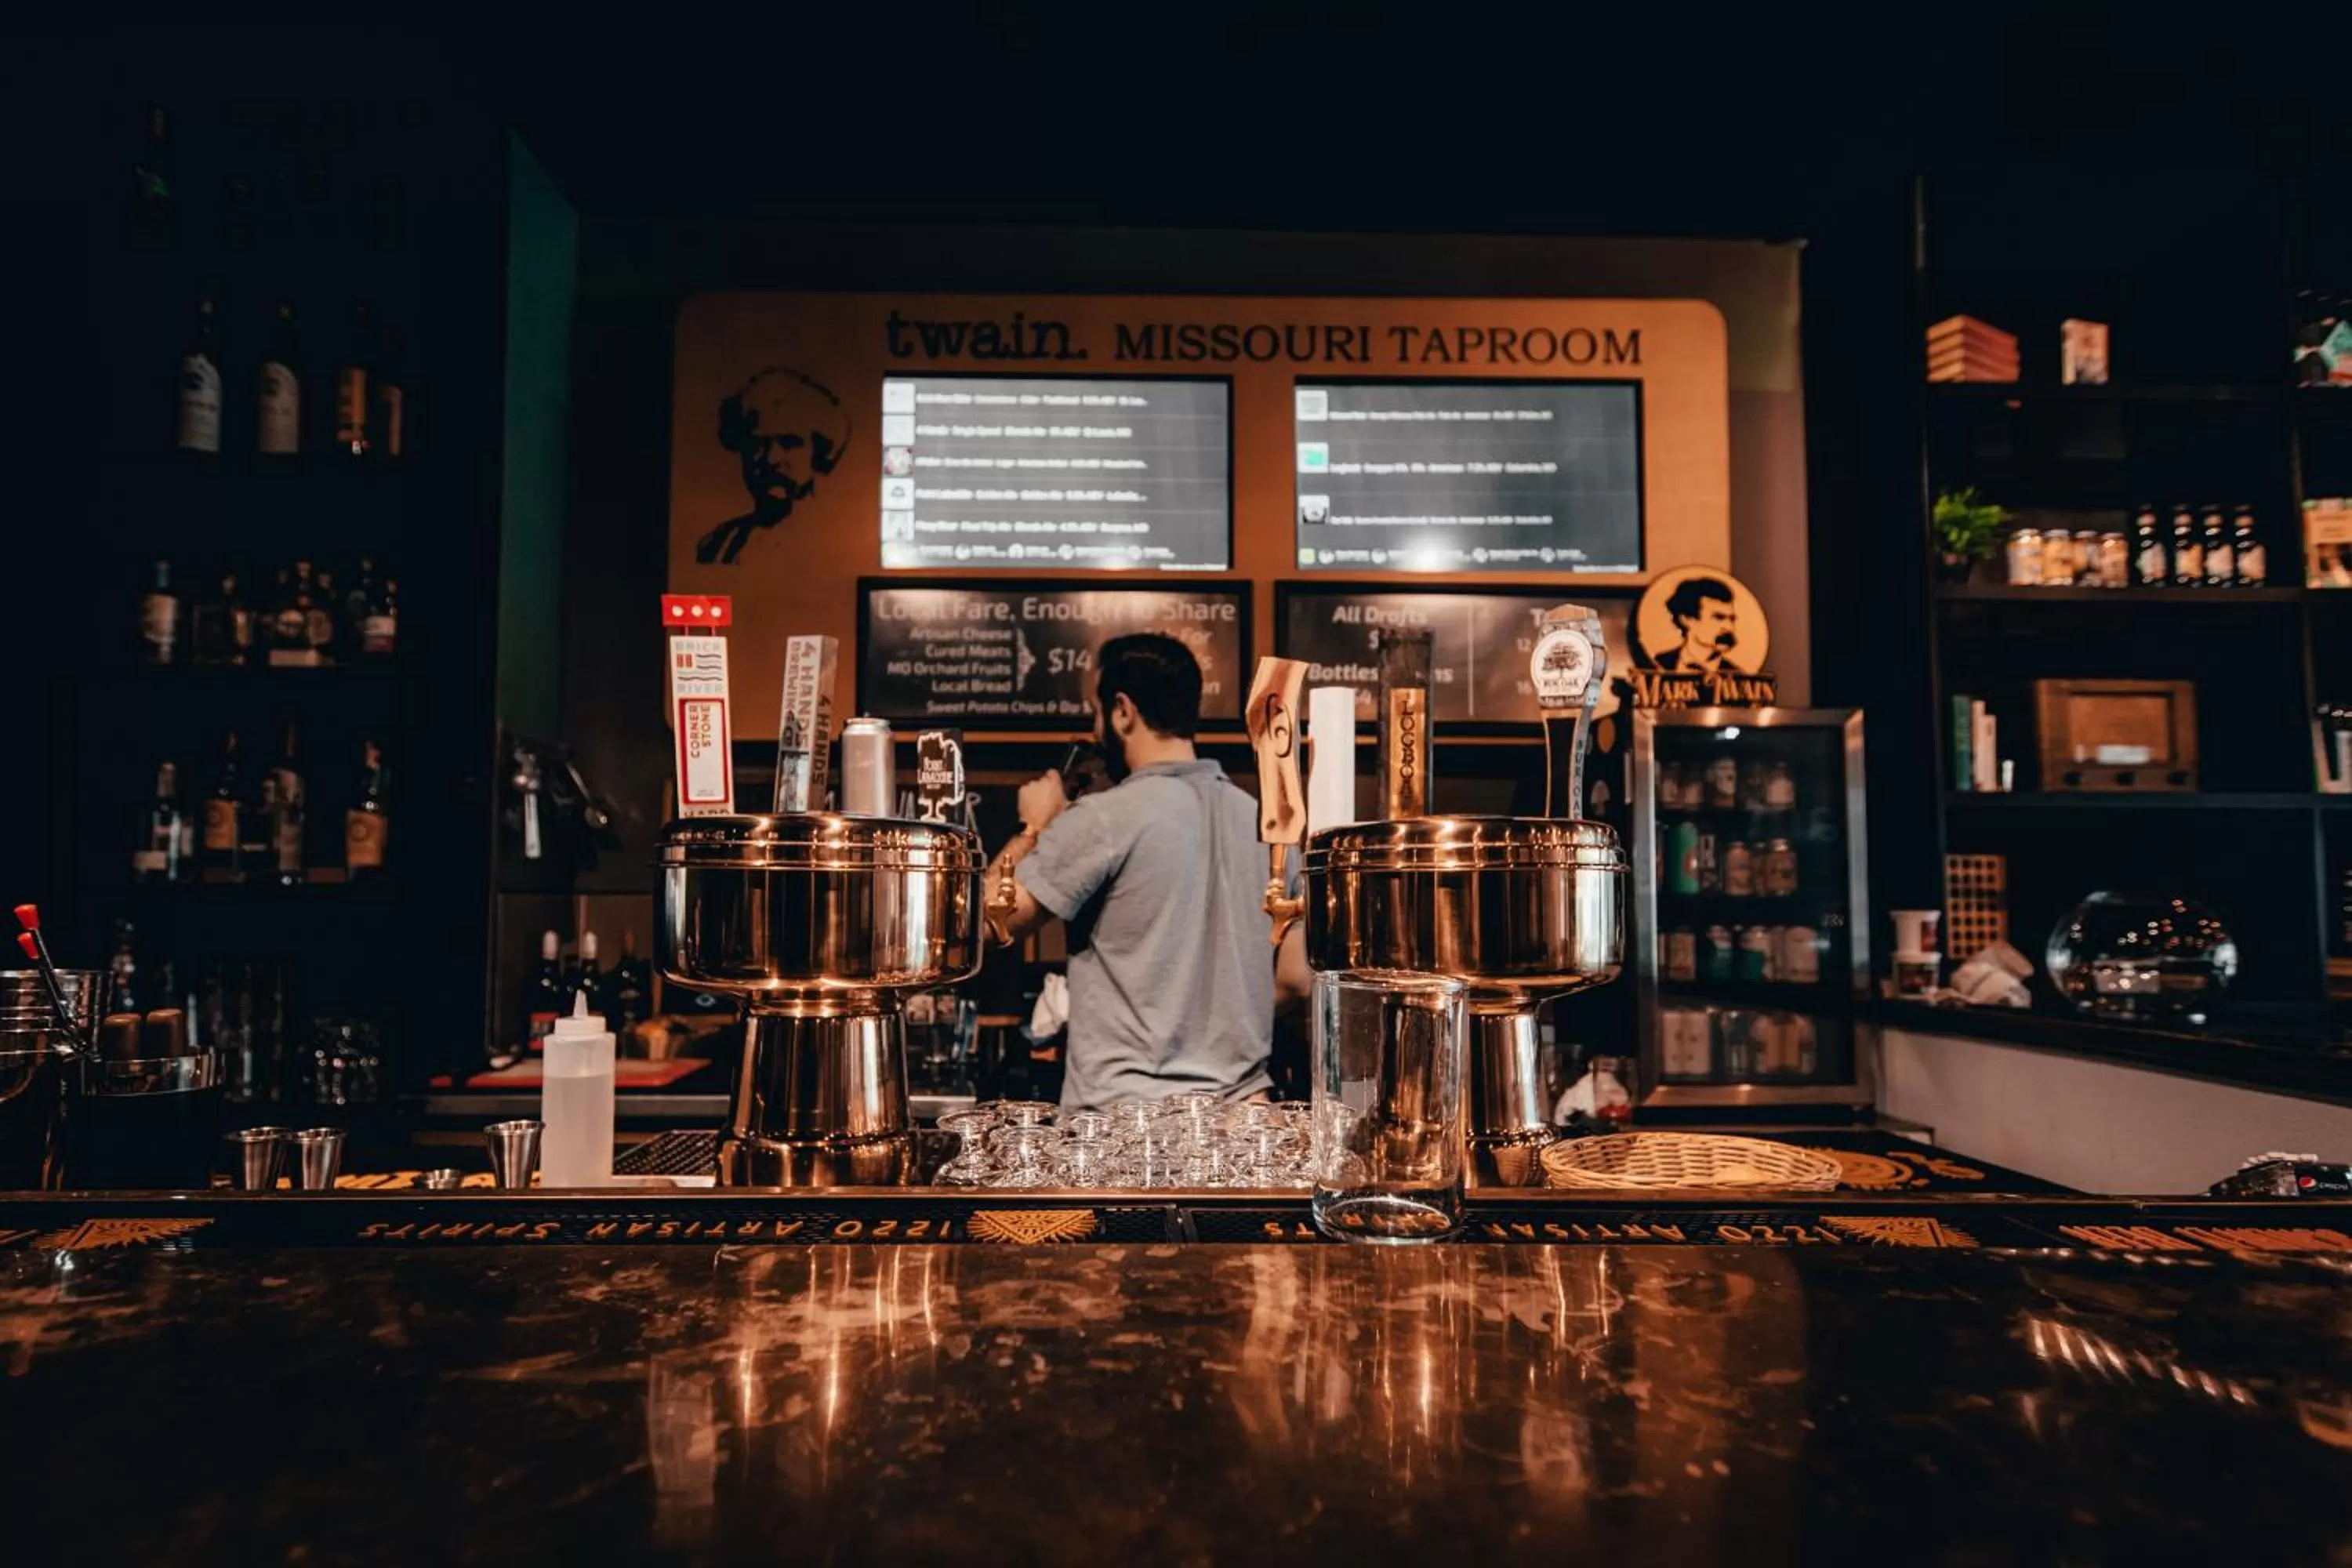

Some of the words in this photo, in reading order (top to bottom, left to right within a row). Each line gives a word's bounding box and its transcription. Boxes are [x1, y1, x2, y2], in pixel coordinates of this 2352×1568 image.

[885, 310, 1088, 361] twain.
[1114, 323, 1372, 364] MISSOURI
[1387, 325, 1643, 365] TAPROOM
[953, 598, 1016, 622] Fare,
[1164, 597, 1237, 622] Share
[1333, 605, 1360, 623] All
[1307, 663, 1379, 682] Bottles
[677, 683, 723, 695] RIVER
[796, 666, 815, 748] HANDS
[688, 704, 701, 759] CORNER
[701, 704, 711, 748] STONE
[358, 1221, 561, 1241] SPIRITS
[584, 1220, 804, 1241] ARTISAN
[833, 1220, 953, 1238] IZZO
[1484, 1221, 1686, 1242] ARTISAN
[1715, 1224, 1842, 1245] IZZO
